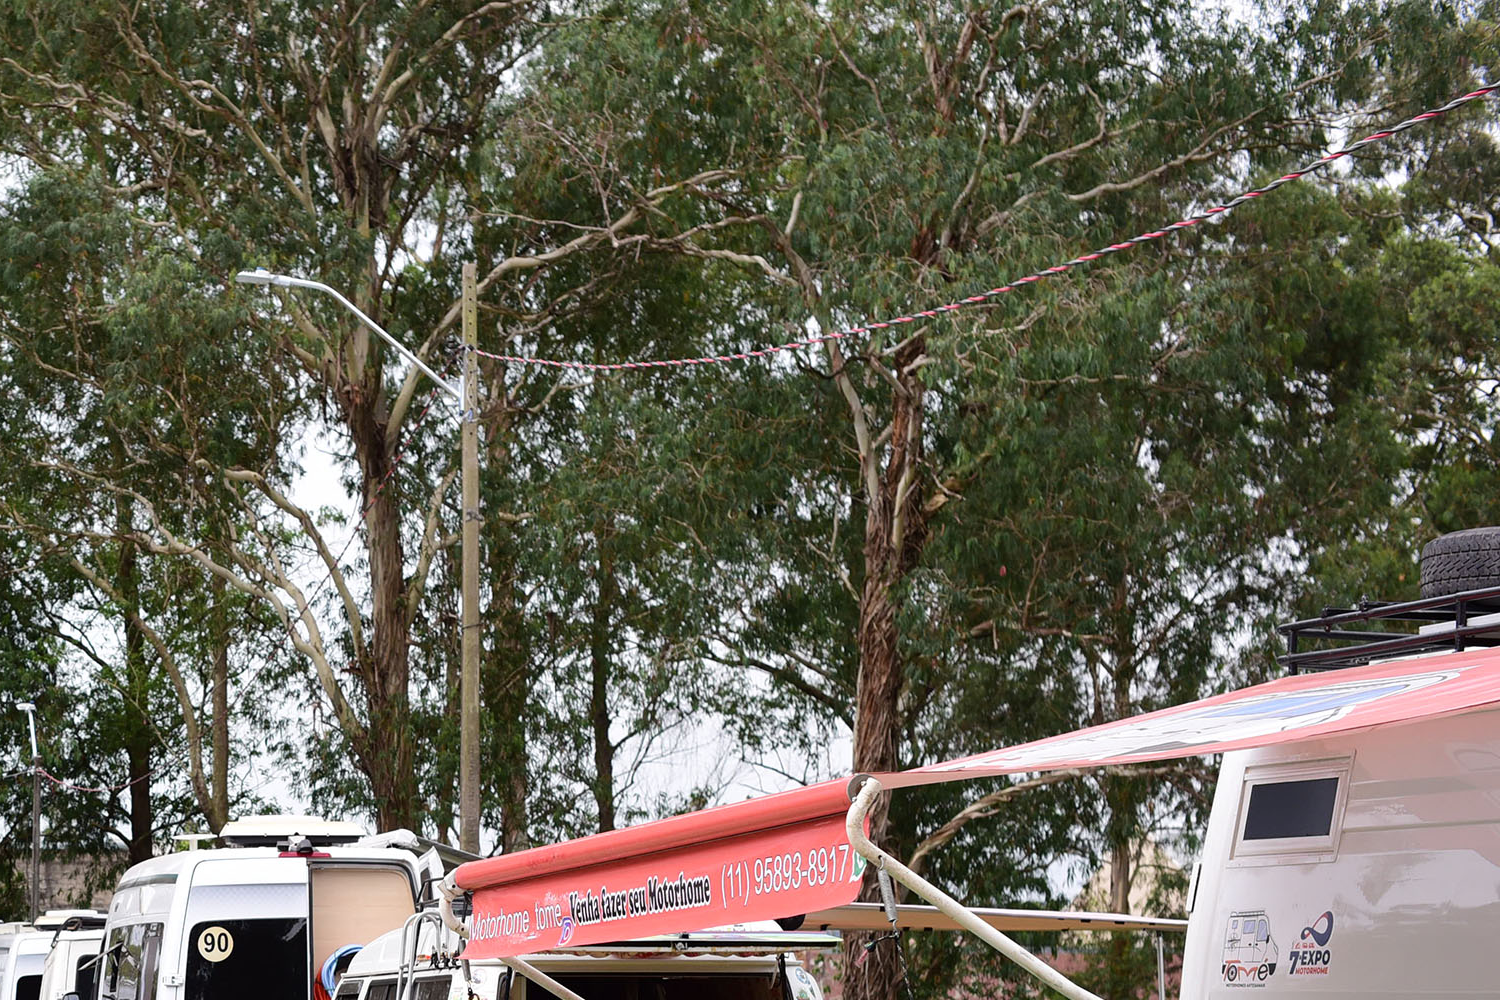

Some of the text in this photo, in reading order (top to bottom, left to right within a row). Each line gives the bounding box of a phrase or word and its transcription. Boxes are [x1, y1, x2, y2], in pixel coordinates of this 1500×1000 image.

[569, 889, 601, 927] Venha
[601, 885, 627, 922] fazer
[628, 887, 647, 917] seu
[648, 871, 711, 915] Motorhome
[721, 861, 750, 909] (11)
[754, 844, 849, 895] 95893-8917
[204, 932, 229, 953] 90
[1301, 950, 1331, 966] EXPO
[1223, 958, 1269, 982] Tomé
[1295, 966, 1329, 975] MOTORHOME
